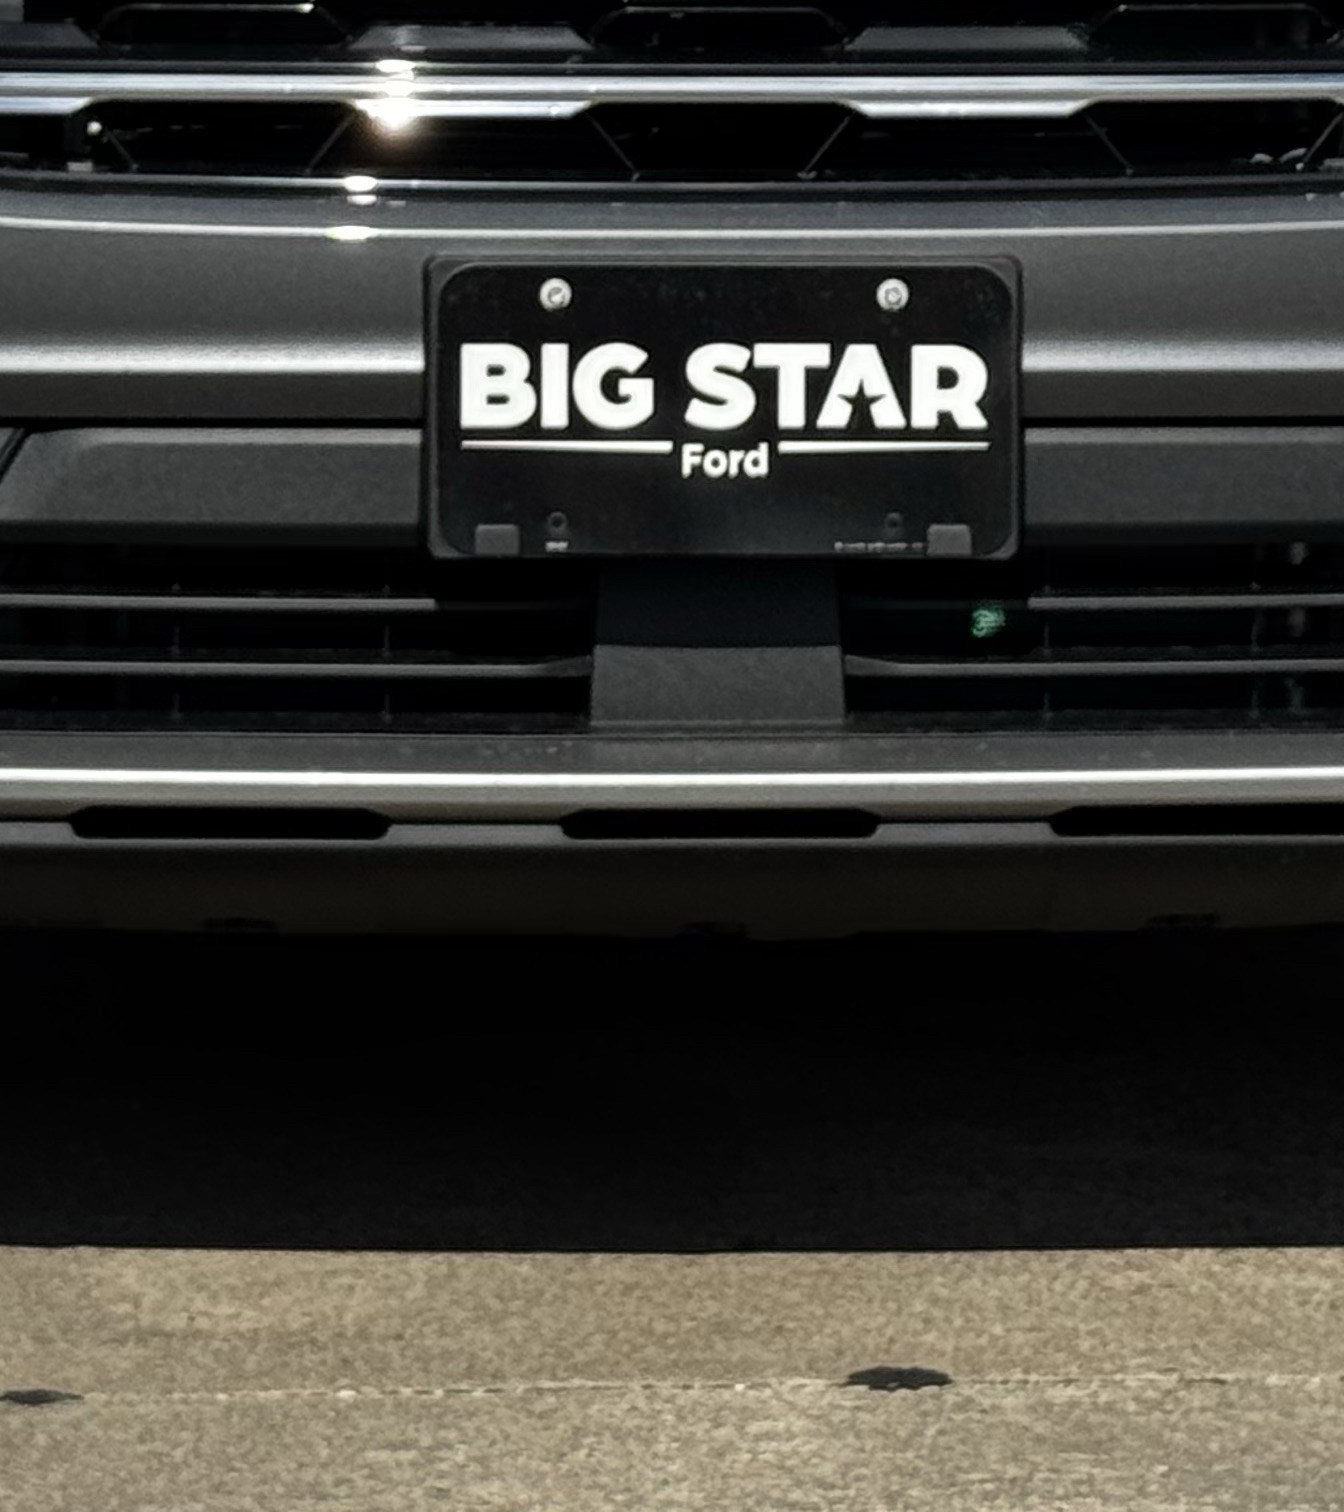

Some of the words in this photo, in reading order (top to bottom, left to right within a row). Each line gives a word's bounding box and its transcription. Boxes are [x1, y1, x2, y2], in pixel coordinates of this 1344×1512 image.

[459, 342, 655, 431] BIG
[683, 342, 989, 431] STAR
[680, 442, 771, 478] Ford
